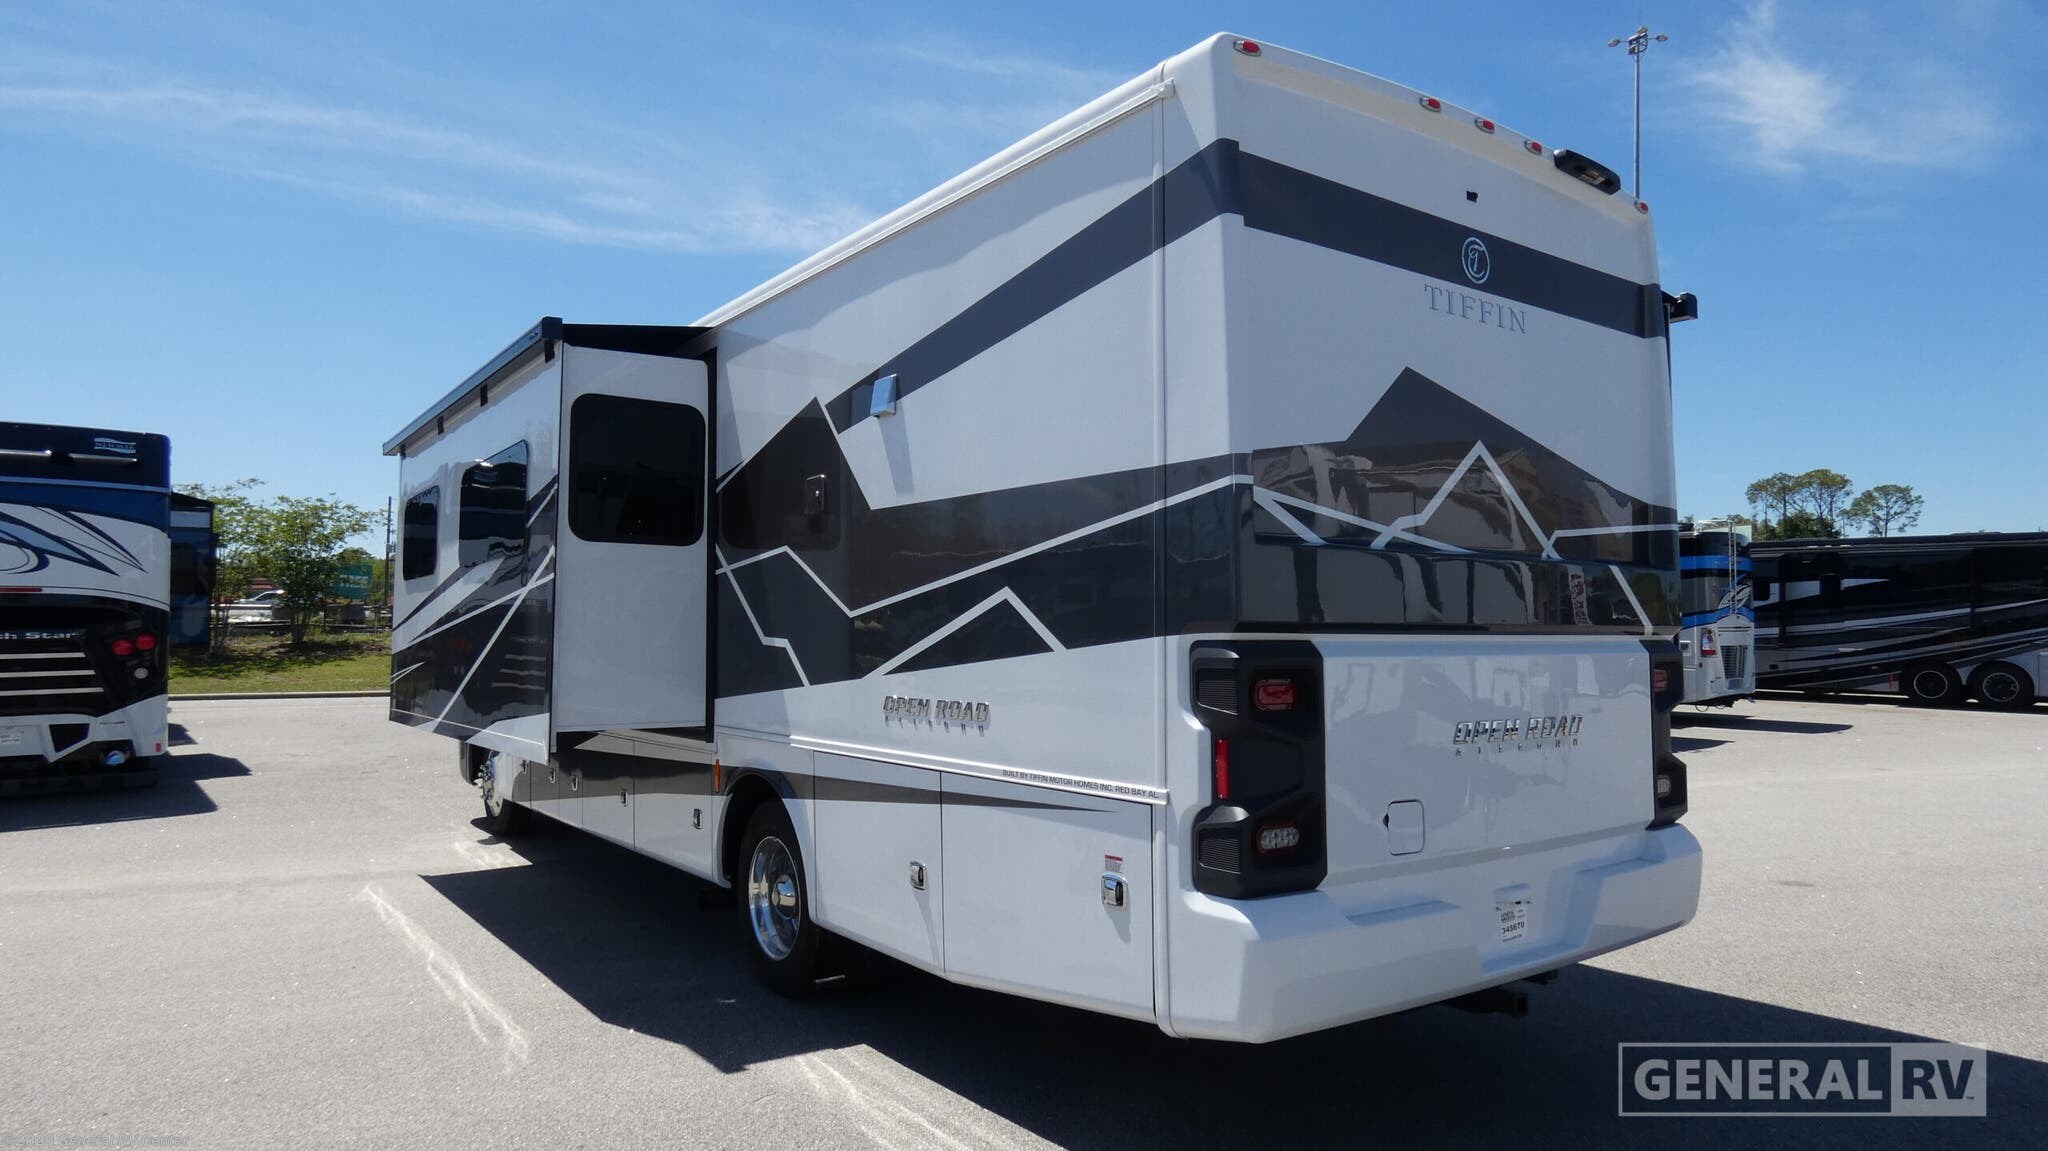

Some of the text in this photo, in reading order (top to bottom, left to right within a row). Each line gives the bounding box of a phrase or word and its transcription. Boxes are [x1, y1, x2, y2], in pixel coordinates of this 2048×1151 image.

[1424, 283, 1527, 334] TIFFIN
[25, 631, 77, 640] Star
[883, 695, 990, 723] OPEN ROAD
[1453, 714, 1583, 745] OPEN ROAD
[1002, 769, 1019, 778] BUILT
[1020, 771, 1028, 779] BY
[1029, 773, 1048, 782] TIFFIN
[1049, 775, 1073, 785] MOTOR
[1073, 779, 1099, 789] HOMES
[1115, 785, 1130, 794] RED
[1131, 788, 1146, 797] BAY
